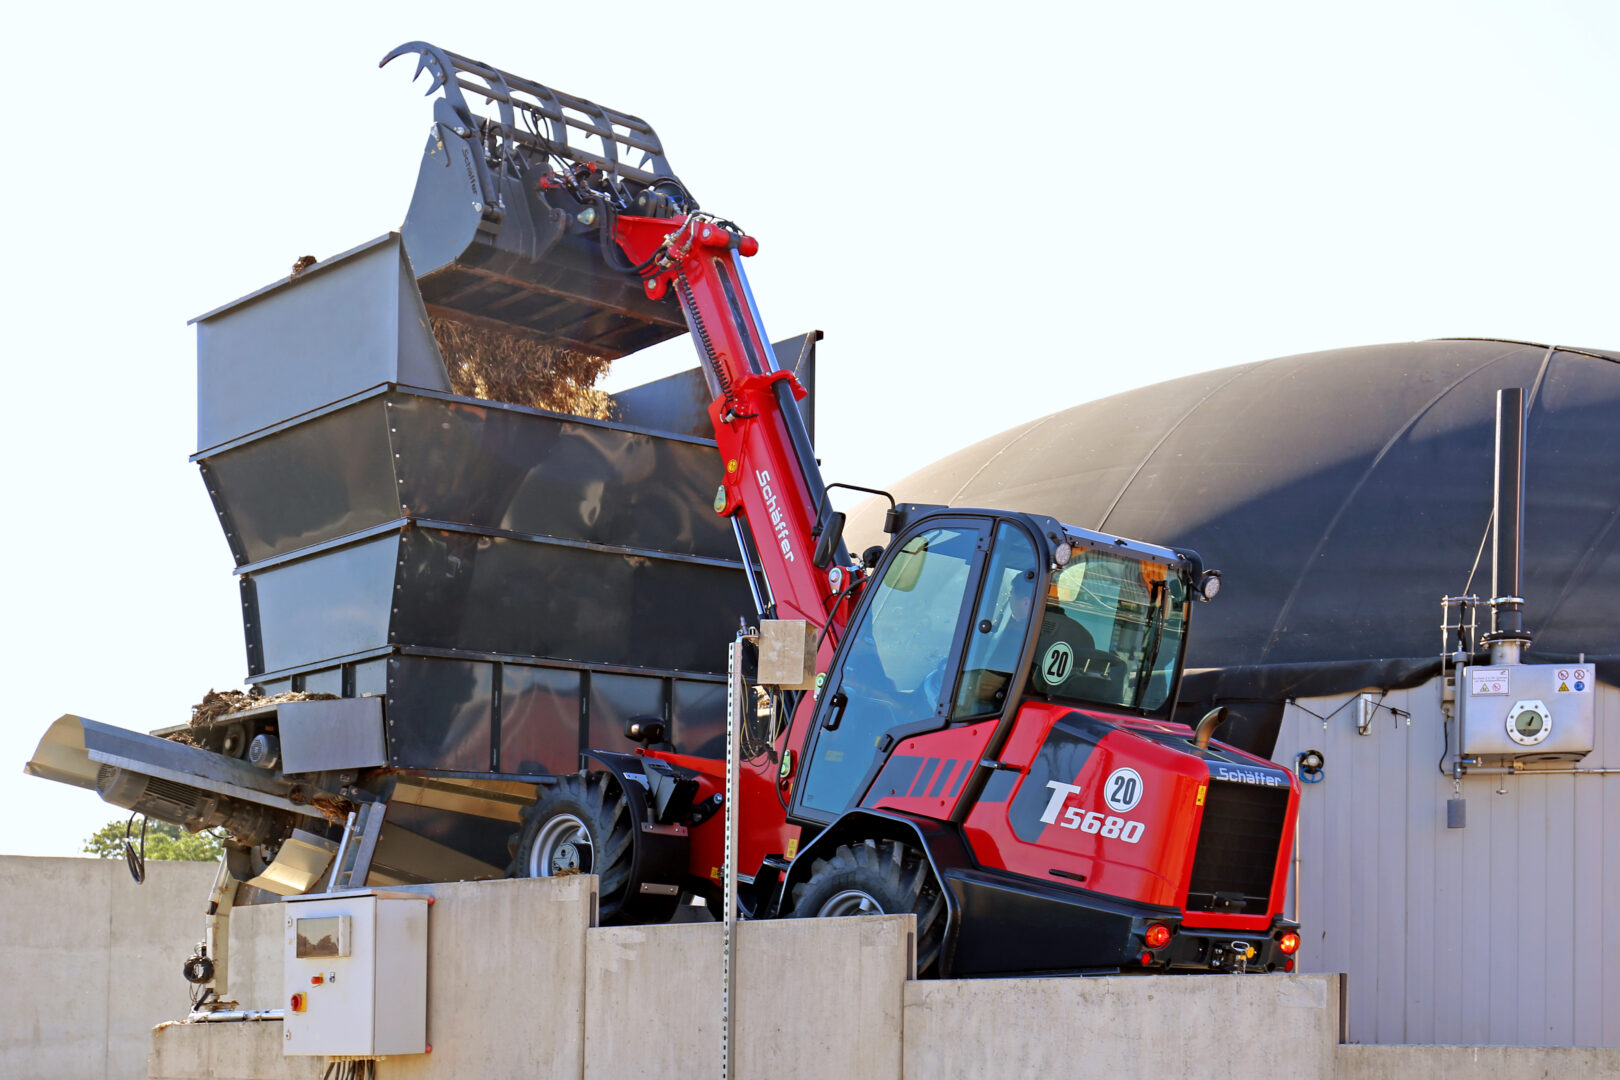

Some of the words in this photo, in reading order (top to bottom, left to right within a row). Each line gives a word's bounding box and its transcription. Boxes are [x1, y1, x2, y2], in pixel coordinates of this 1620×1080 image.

[755, 469, 795, 562] Schäffer
[1046, 649, 1069, 678] 20
[1110, 775, 1137, 806] 20
[1215, 767, 1282, 788] Schäffer
[1060, 806, 1146, 844] 5680
